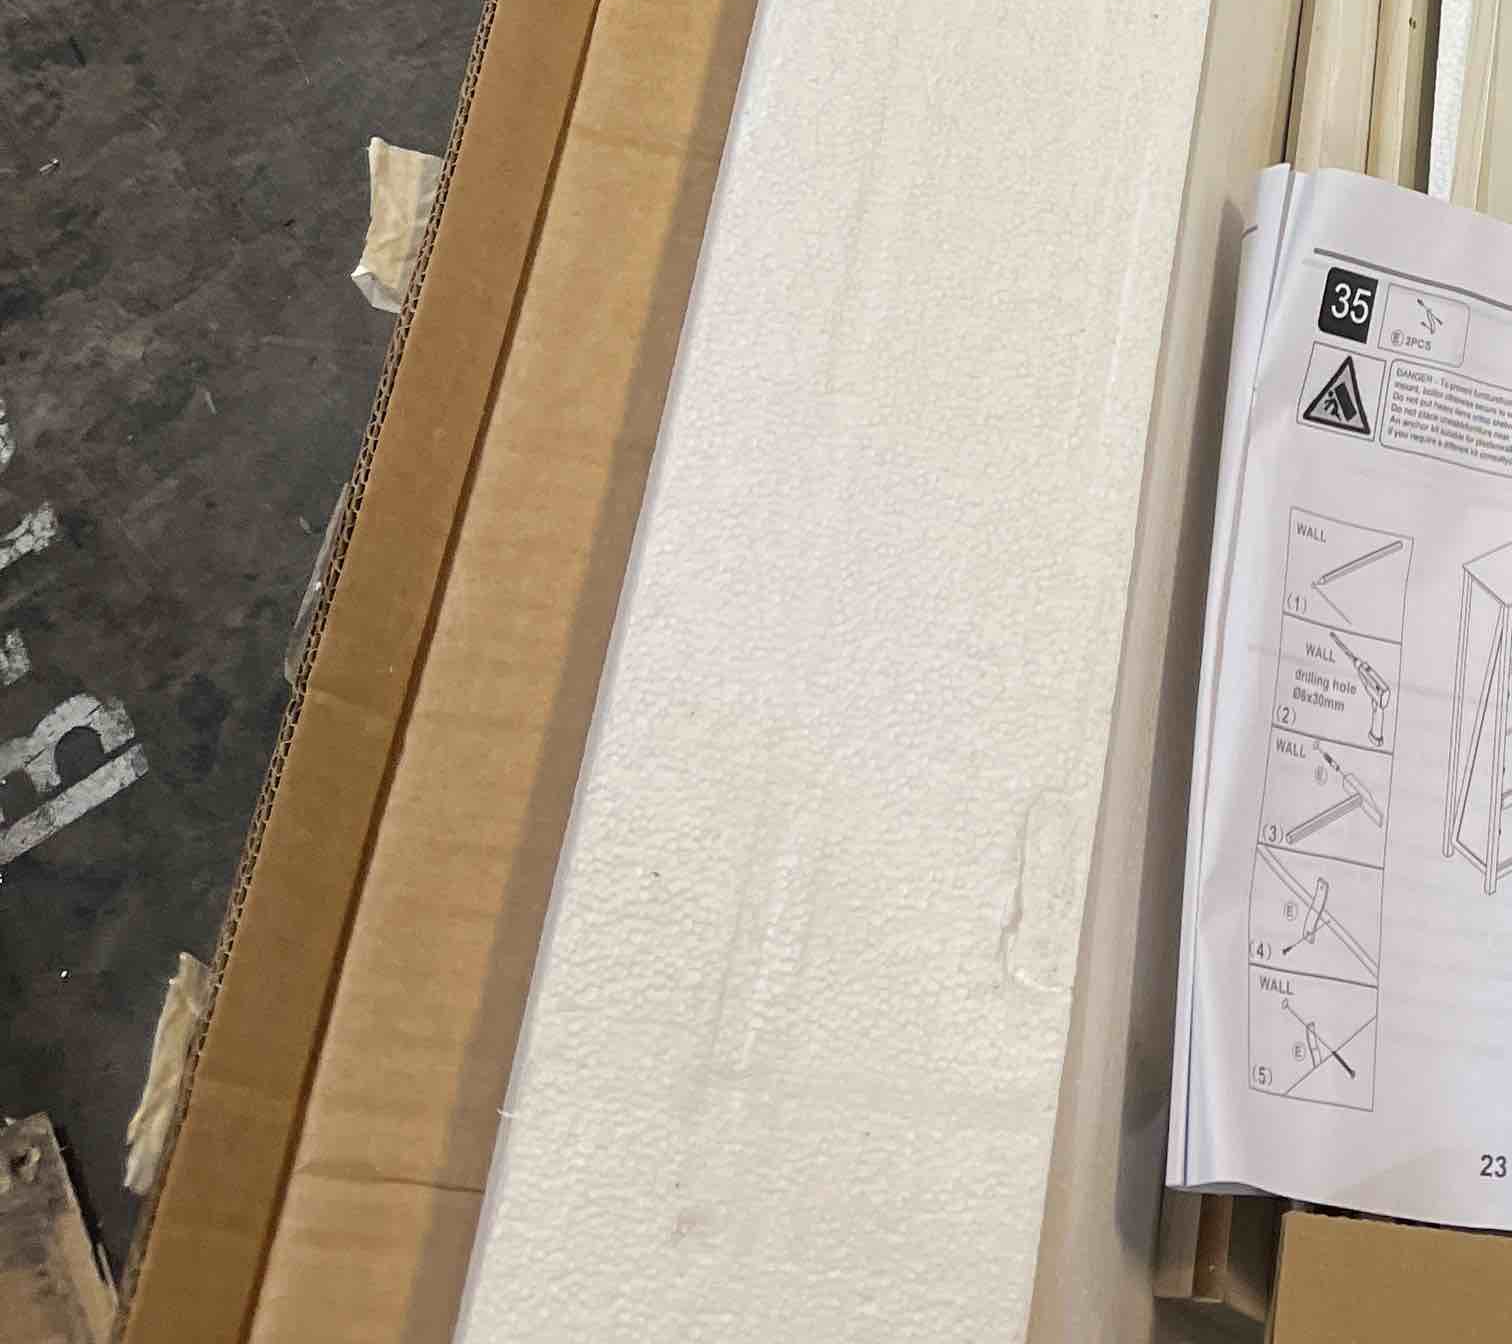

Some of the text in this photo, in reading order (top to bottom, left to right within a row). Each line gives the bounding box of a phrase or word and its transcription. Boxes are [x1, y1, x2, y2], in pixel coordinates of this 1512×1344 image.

[1331, 282, 1372, 325] 35
[1296, 522, 1327, 544] WALL
[1286, 592, 1308, 614] (1)
[1304, 641, 1336, 664] WALL
[1295, 668, 1357, 696] drilling hole
[1276, 703, 1297, 727] (2)
[1275, 737, 1307, 760] WALL
[1262, 822, 1286, 846] (3)
[1249, 937, 1272, 962] (4)
[1258, 975, 1295, 996] WALL
[1252, 1064, 1273, 1087] (5)
[1480, 1153, 1507, 1178] 23
